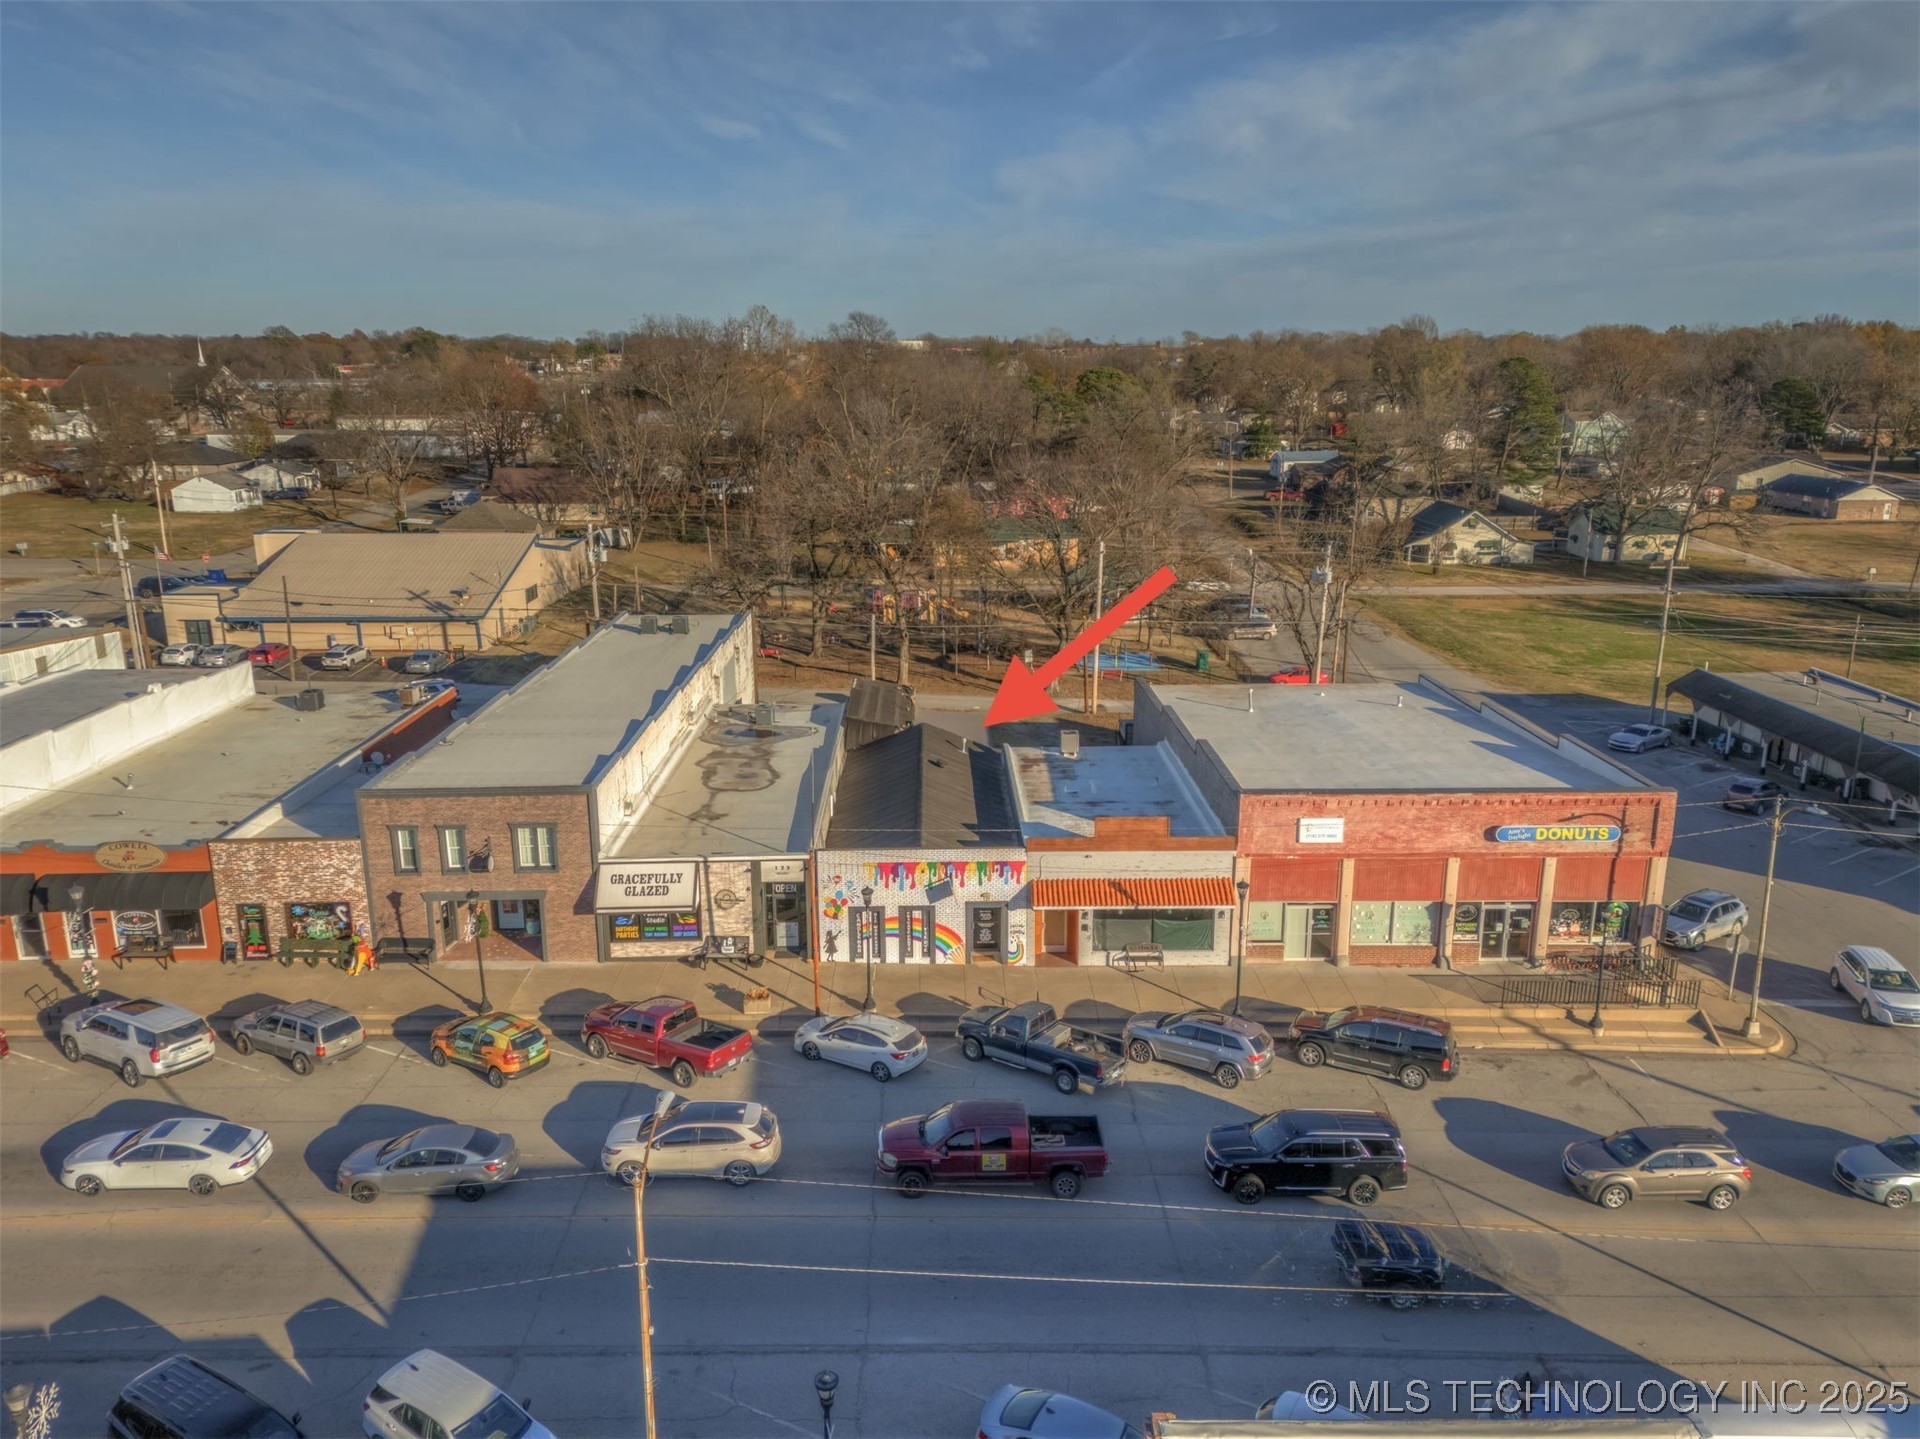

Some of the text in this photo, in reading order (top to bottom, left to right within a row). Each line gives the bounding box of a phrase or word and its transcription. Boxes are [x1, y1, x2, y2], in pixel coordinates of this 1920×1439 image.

[1508, 832, 1531, 841] Daylight
[1535, 827, 1609, 841] DONUTS
[108, 842, 148, 851] COWETA
[610, 873, 683, 885] GRACEFULLY
[624, 885, 670, 897] GLAZED
[774, 884, 797, 893] OPEN
